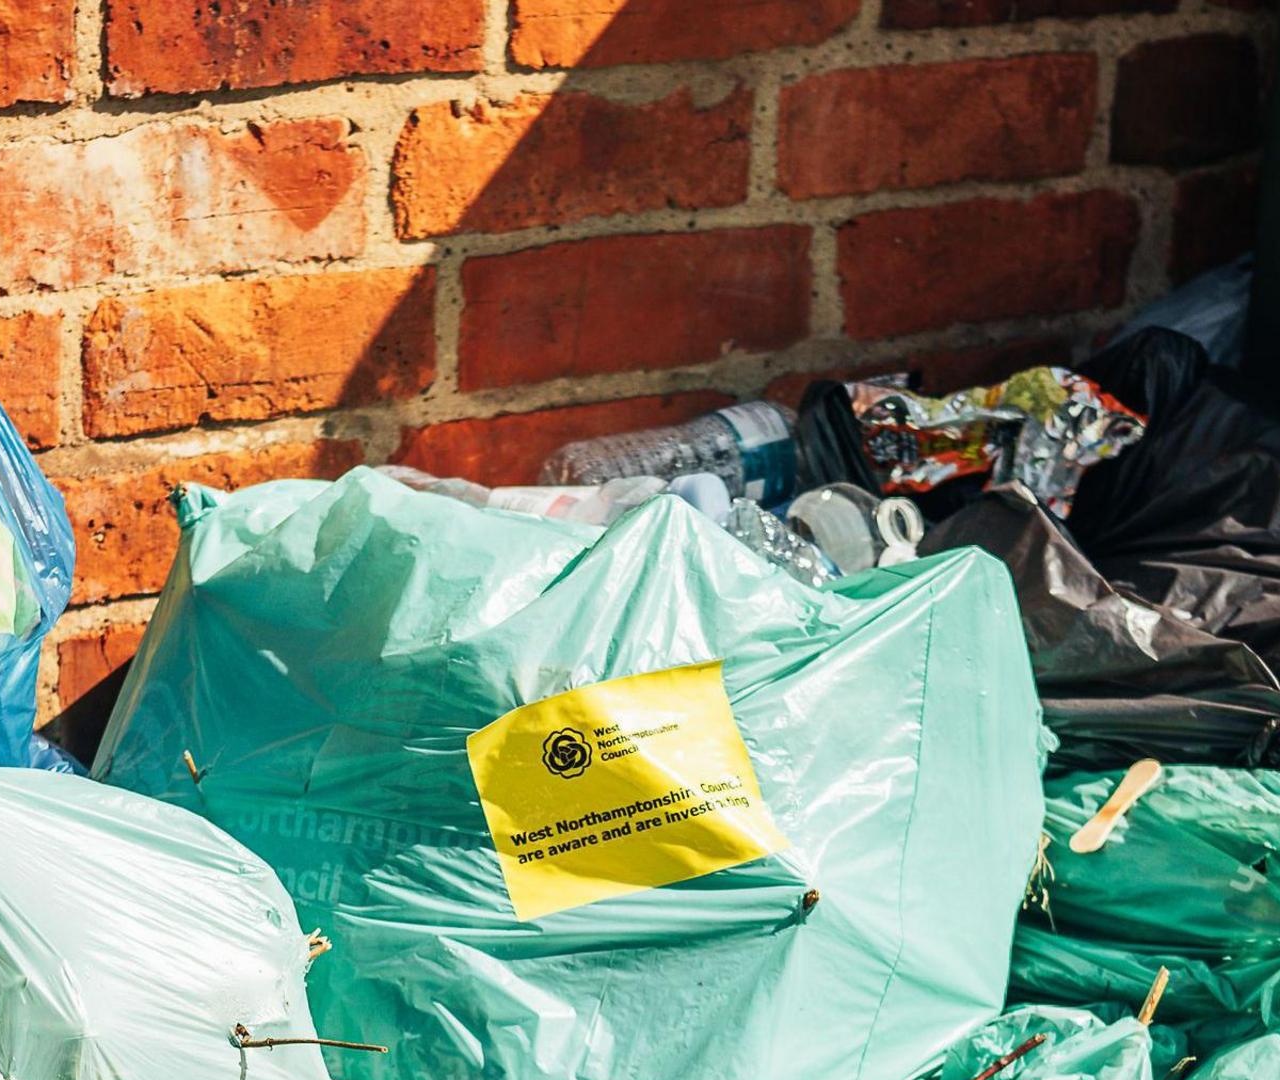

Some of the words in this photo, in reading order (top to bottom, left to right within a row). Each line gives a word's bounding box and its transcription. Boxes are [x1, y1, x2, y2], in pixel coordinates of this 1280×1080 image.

[593, 724, 620, 738] West
[597, 724, 678, 750] Northmptonshire
[510, 825, 554, 846] West
[700, 776, 743, 793] Counc
[517, 849, 545, 864] are
[548, 834, 598, 856] aware
[602, 822, 631, 841] and
[635, 817, 662, 832] are
[665, 796, 750, 823] investiting
